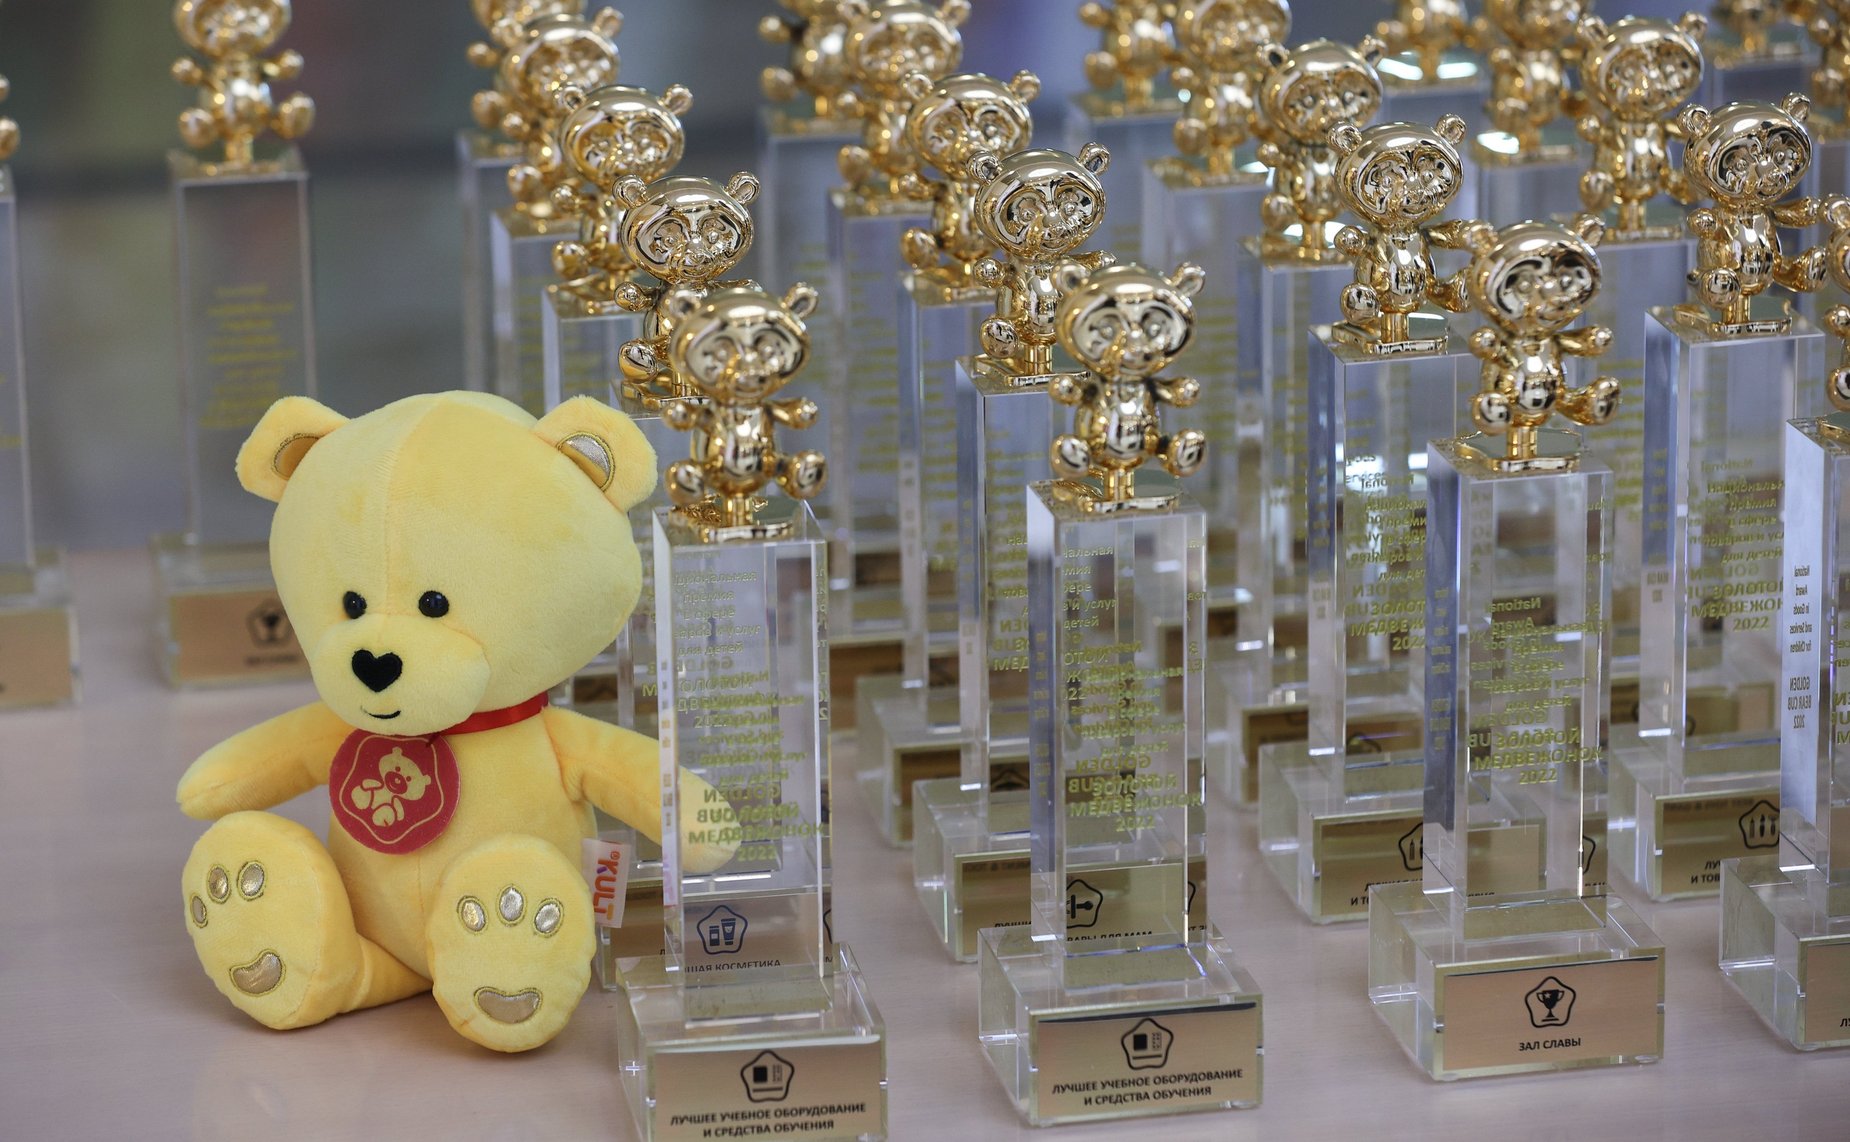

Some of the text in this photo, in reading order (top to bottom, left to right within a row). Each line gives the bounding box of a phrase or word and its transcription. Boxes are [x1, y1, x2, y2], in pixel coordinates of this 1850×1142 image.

[1350, 617, 1427, 637] МЕДВЕЖ
[1733, 616, 1769, 633] 2022
[1519, 768, 1558, 785] 2022
[1519, 1038, 1581, 1051] ЗАЛ СЛАВЫ
[1052, 1069, 1243, 1095] ЛУЧШЕЕ УЧЕБНОЕ ОБОРУДОВАНИЕ
[1084, 1086, 1212, 1106] И СРЕДСТВА ОБУЧЕНИЯ
[670, 1102, 866, 1127] ЛУЧШЕЕ УЧЕБНОЕ ОБОРУДОВАНИЕ
[703, 1120, 834, 1138] И СРЕДСТВА ОБУЧЕНИЯ
